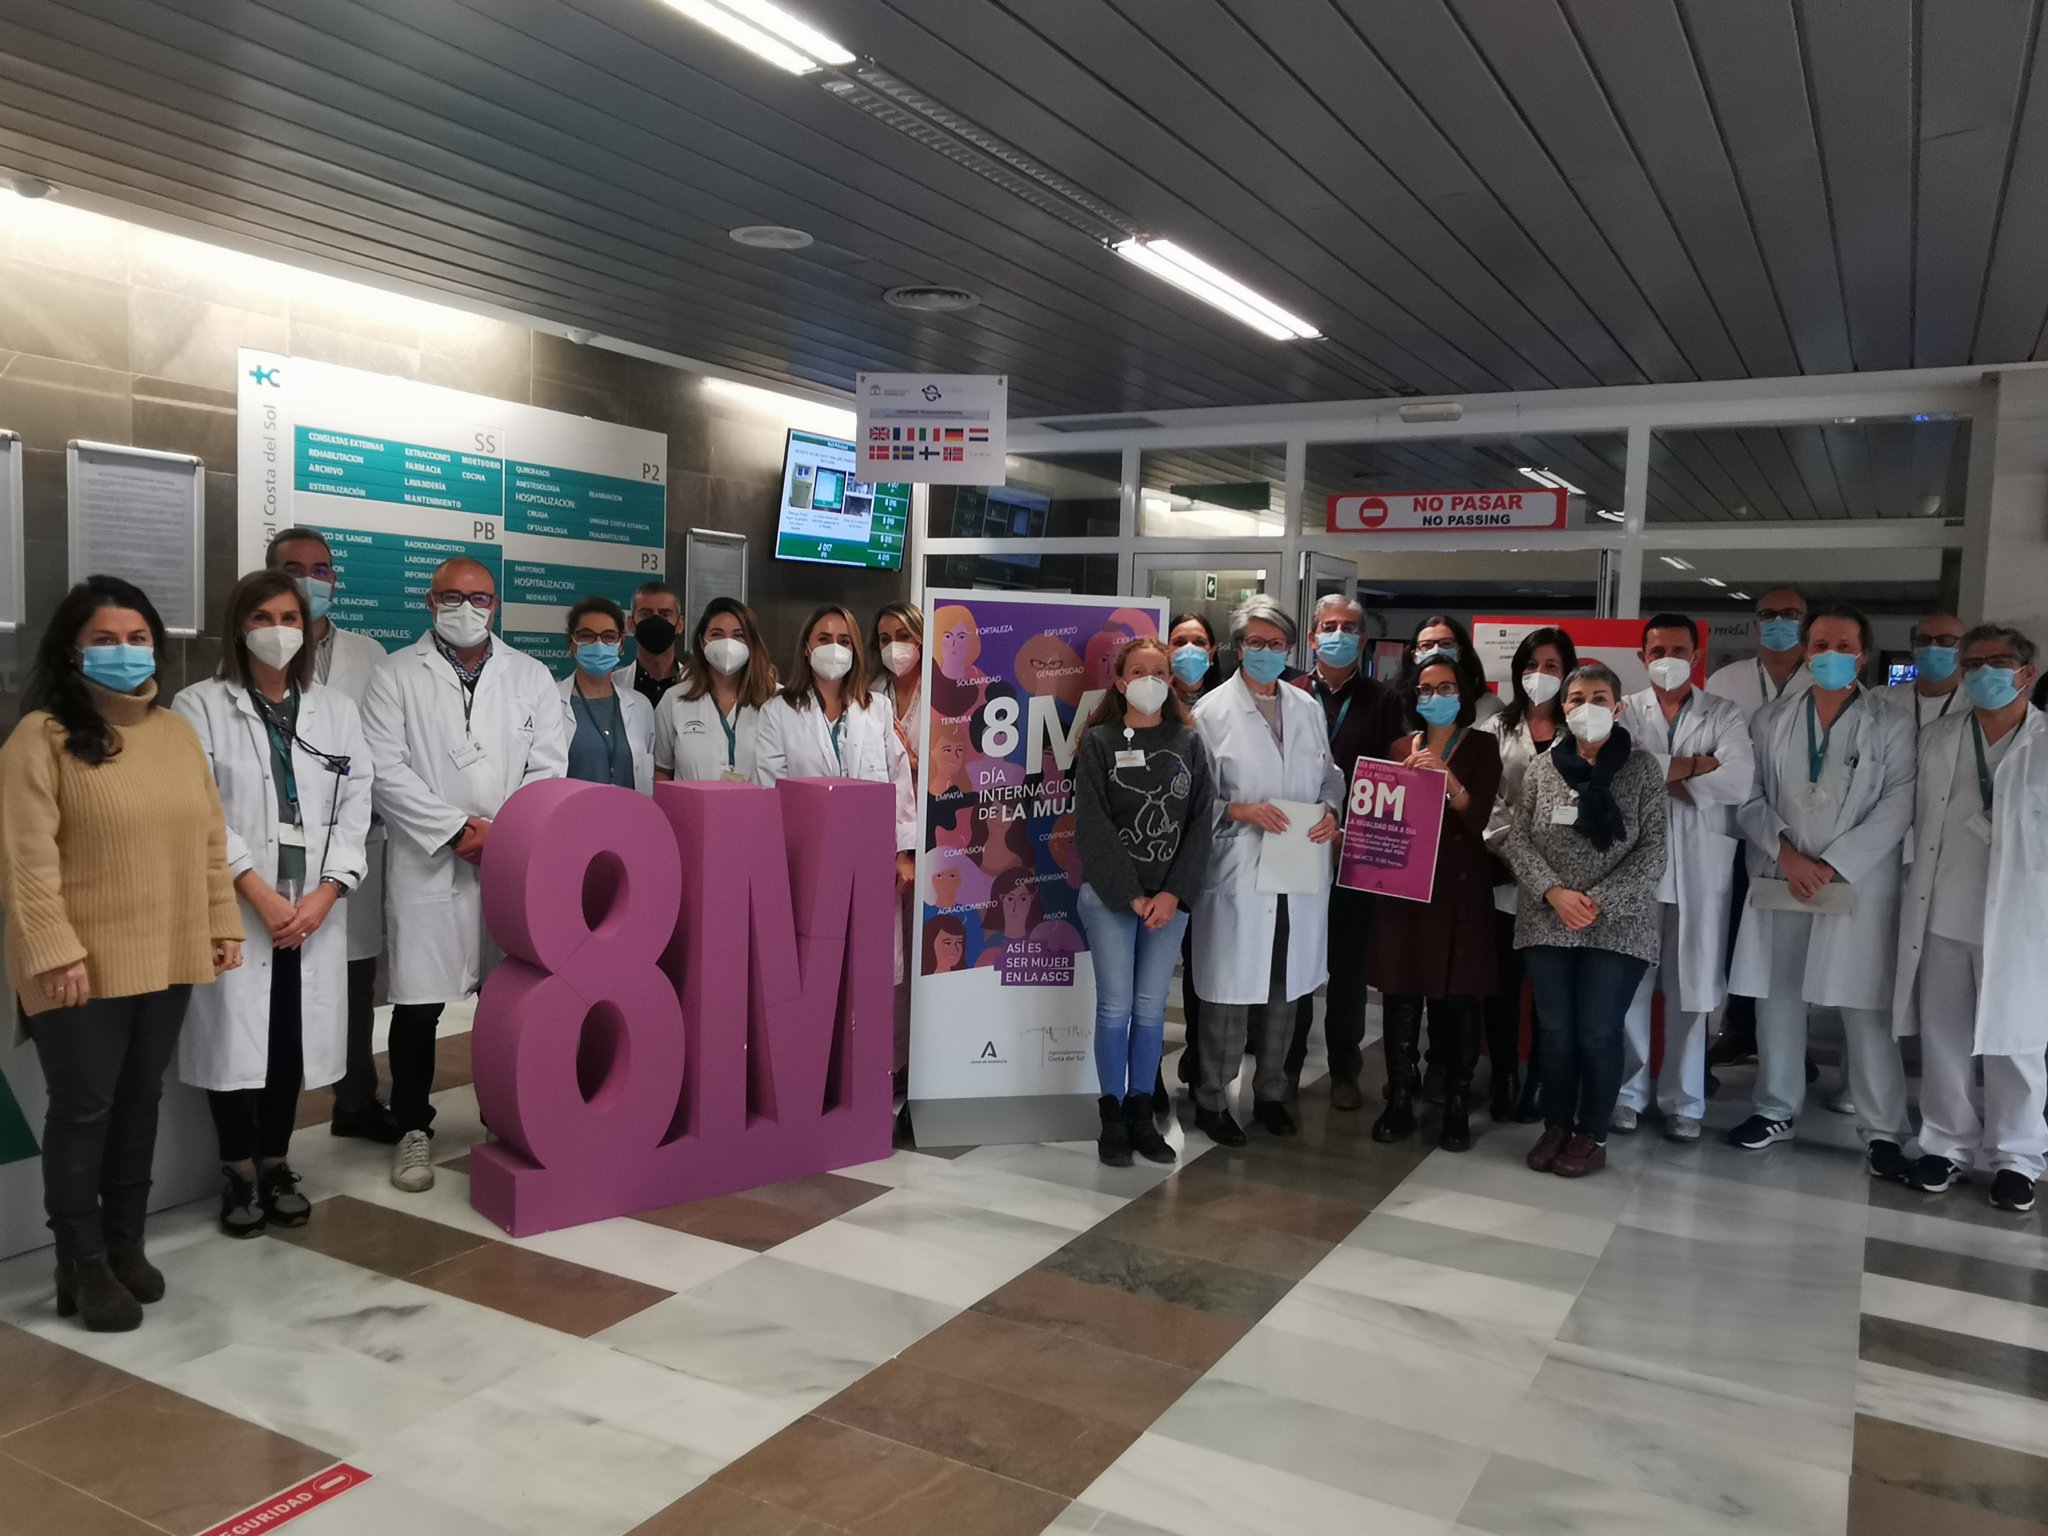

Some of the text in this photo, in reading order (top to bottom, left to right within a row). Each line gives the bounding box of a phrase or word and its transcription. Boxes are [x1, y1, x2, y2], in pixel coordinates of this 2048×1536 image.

[263, 405, 277, 430] Sol
[262, 436, 277, 463] del
[308, 432, 385, 453] CONSULTAS EXTERNAS
[474, 433, 496, 454] SS
[404, 448, 452, 463] EXTRACCIONES
[308, 463, 344, 477] ARCHIVO
[405, 461, 442, 475] FARMACIA
[642, 462, 660, 481] P2
[461, 471, 486, 482] COCINA
[263, 468, 277, 516] Costa
[404, 477, 447, 492] LAVANDERÍA
[404, 493, 462, 509] MANTENIMIENTO
[1413, 494, 1523, 512] NO PASAR
[1422, 514, 1511, 526] NO PASSING
[473, 520, 496, 541] PB
[335, 533, 345, 541] DE
[345, 534, 373, 544] SANGRE
[641, 553, 659, 571] P3
[340, 597, 379, 607] ORACIONES
[975, 624, 1013, 636] FORTALEZA
[1044, 626, 1078, 637] ESFUERZO
[1036, 666, 1084, 679] GENEROSIDAD
[956, 675, 1001, 687] SOLIDARIDAD
[940, 716, 972, 725] TERNURA
[981, 689, 1107, 775] 8M
[979, 766, 1006, 785] DÍA
[935, 790, 964, 802] EMPATÍA
[978, 778, 1076, 803] INTERNACIO
[1351, 778, 1406, 822] 8M
[978, 797, 1076, 822] DE LA MUJ
[1355, 819, 1387, 830] IGUALDAD
[1038, 830, 1075, 842] COMPROM
[943, 845, 986, 858] COMPASIÓN
[1014, 872, 1069, 887] COMPAÑERISMO
[937, 900, 998, 916] AGRADECIMIENTO
[1043, 911, 1068, 920] PASIÓN
[1006, 940, 1041, 954] ASÍ ES
[1006, 957, 1069, 968] SER MUJER
[471, 777, 896, 1172] 8M
[1005, 972, 1070, 983] EN LA ASCS
[219, 1492, 314, 1536] EGURIDAD
